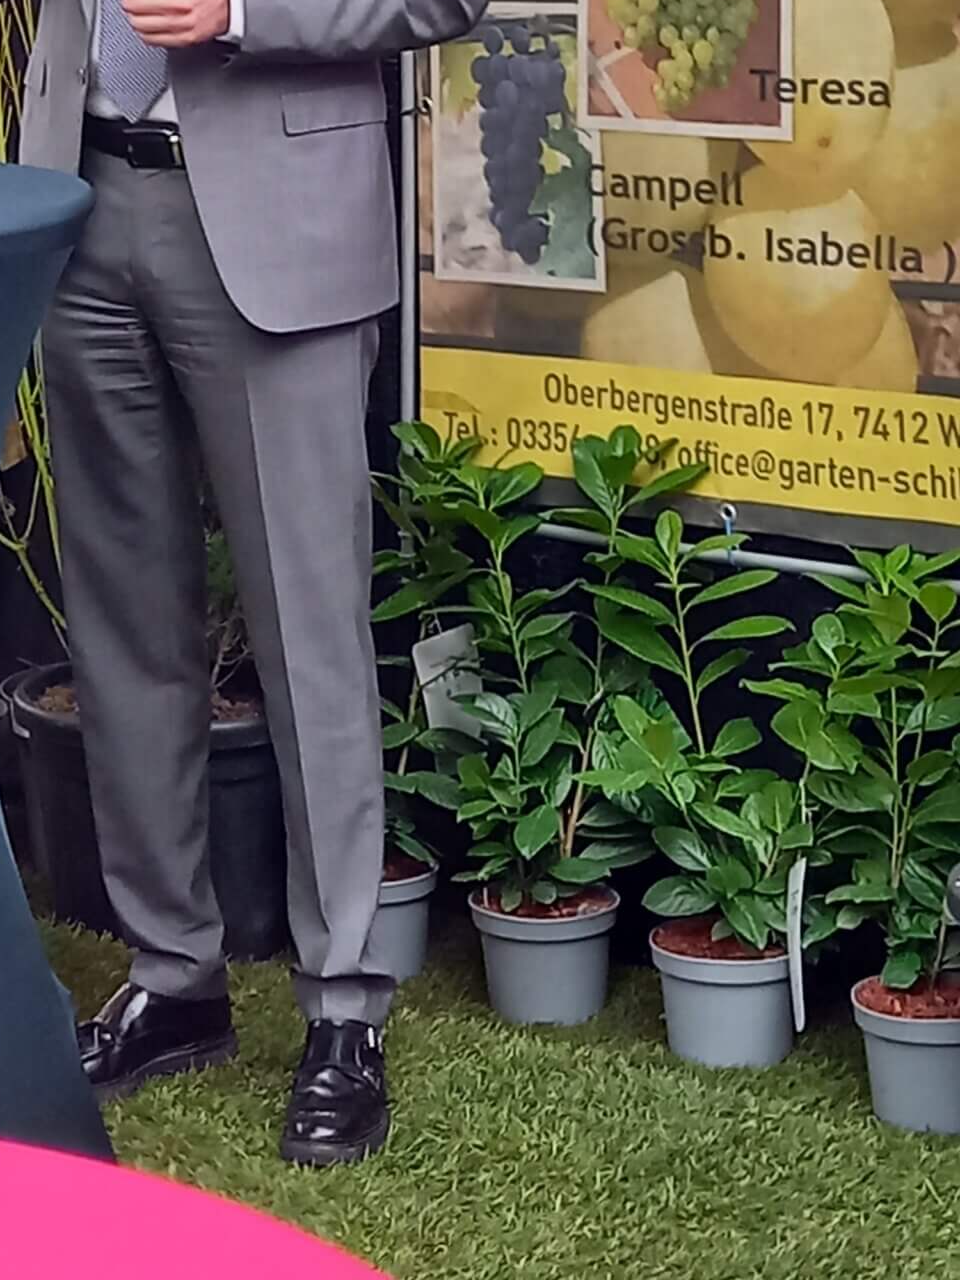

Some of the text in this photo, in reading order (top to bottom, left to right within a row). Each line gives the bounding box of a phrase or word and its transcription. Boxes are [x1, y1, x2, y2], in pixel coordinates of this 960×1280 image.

[749, 68, 892, 108] Teresa
[589, 164, 744, 211] Campell
[765, 228, 924, 274] Isabella
[544, 373, 793, 431] Oberbergenstraße
[802, 401, 844, 441] 17,
[853, 405, 930, 446] 7412
